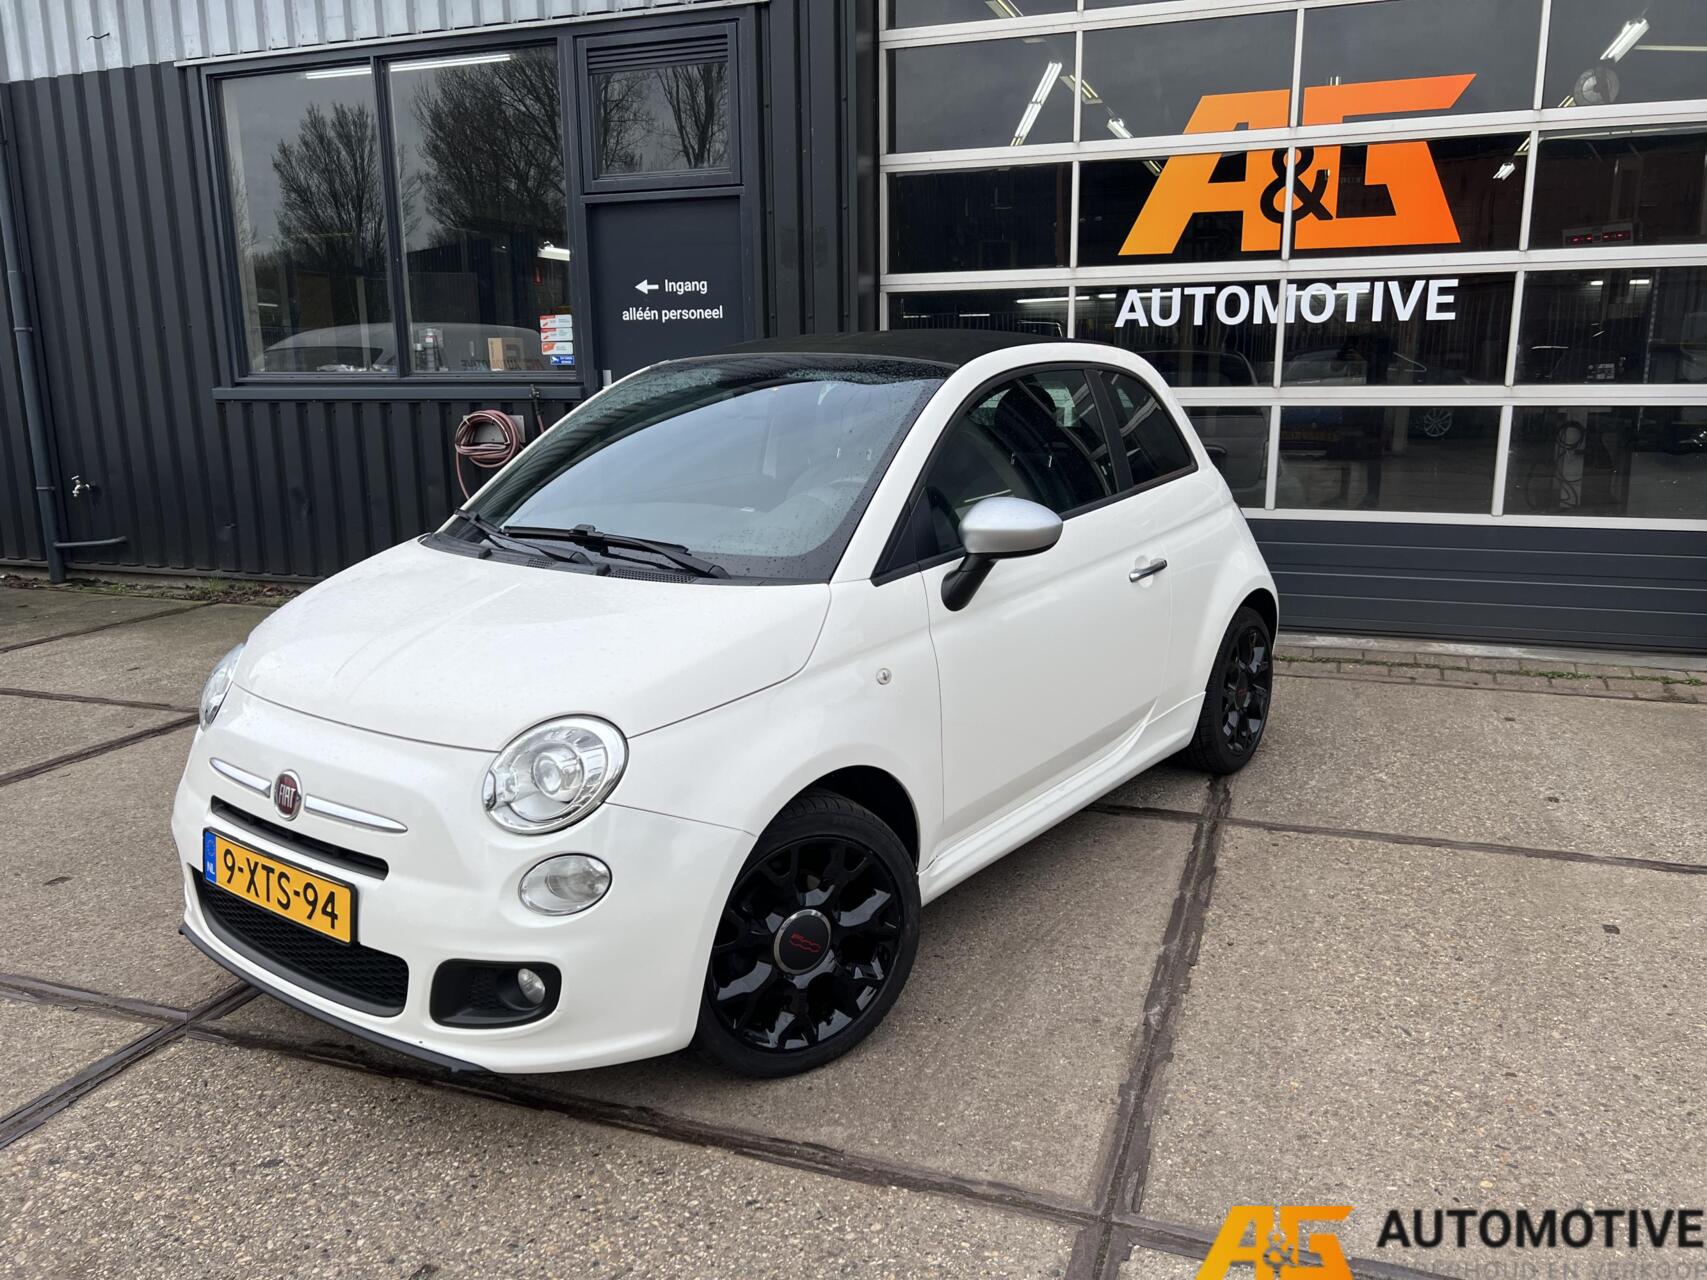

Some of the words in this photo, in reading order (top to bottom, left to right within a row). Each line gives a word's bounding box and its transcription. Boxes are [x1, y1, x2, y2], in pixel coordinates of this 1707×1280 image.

[1118, 73, 1477, 256] A&G
[664, 279, 708, 295] Ingang
[622, 306, 659, 321] alléén
[661, 304, 723, 323] personeel
[1115, 278, 1459, 328] AUTOMOTIVE
[279, 783, 297, 808] FIAT
[206, 860, 216, 875] NL
[222, 848, 339, 930] 9-XTS-94
